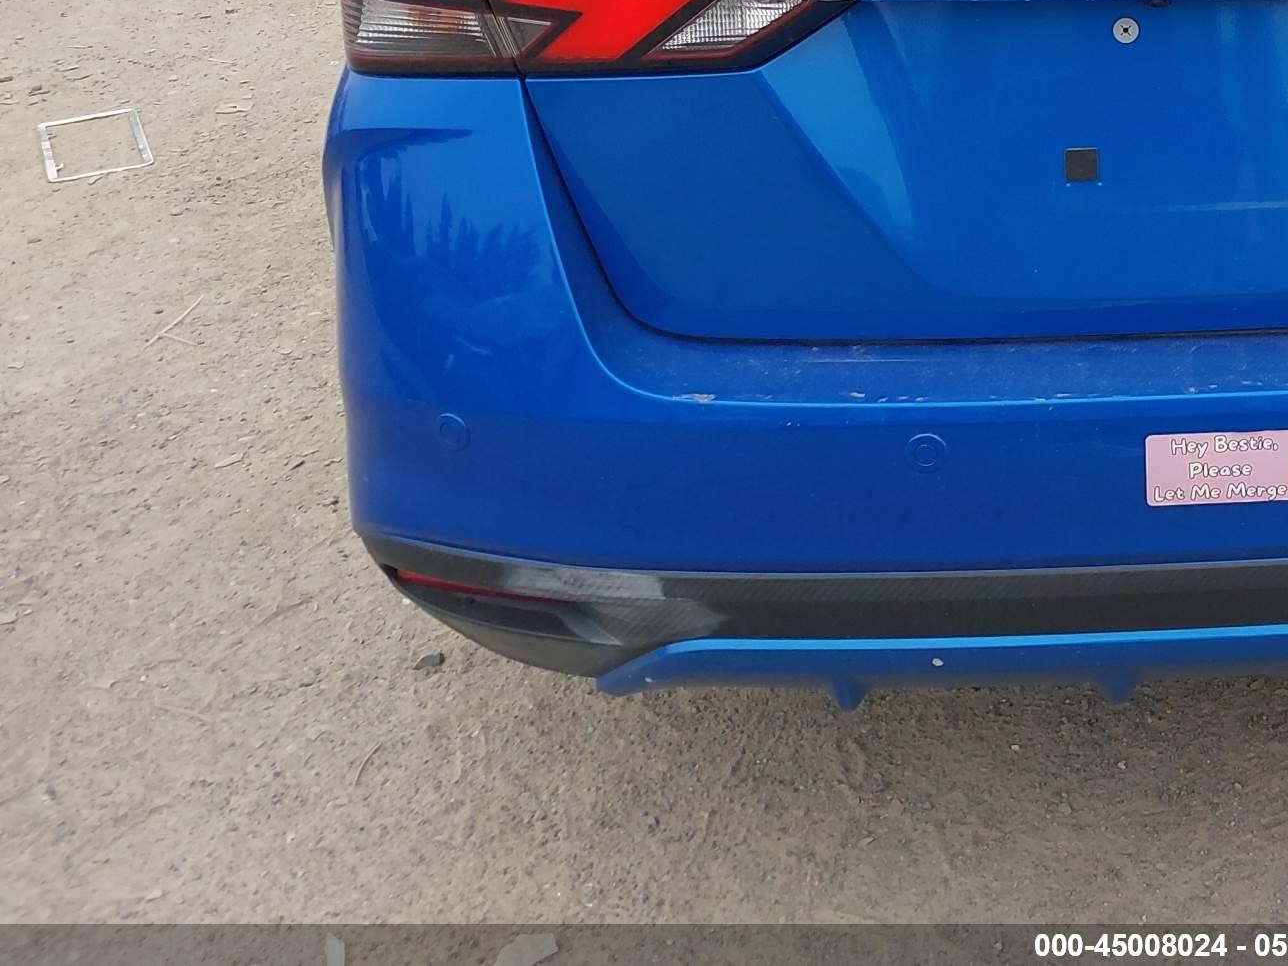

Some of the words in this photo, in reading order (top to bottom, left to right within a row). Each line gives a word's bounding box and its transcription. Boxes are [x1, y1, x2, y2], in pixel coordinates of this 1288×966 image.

[1171, 438, 1208, 458] Hey
[1214, 435, 1279, 453] Bestie,
[1189, 462, 1252, 479] Please
[1154, 486, 1185, 502] Let
[1190, 484, 1221, 500] Me
[1226, 482, 1287, 501] Merge
